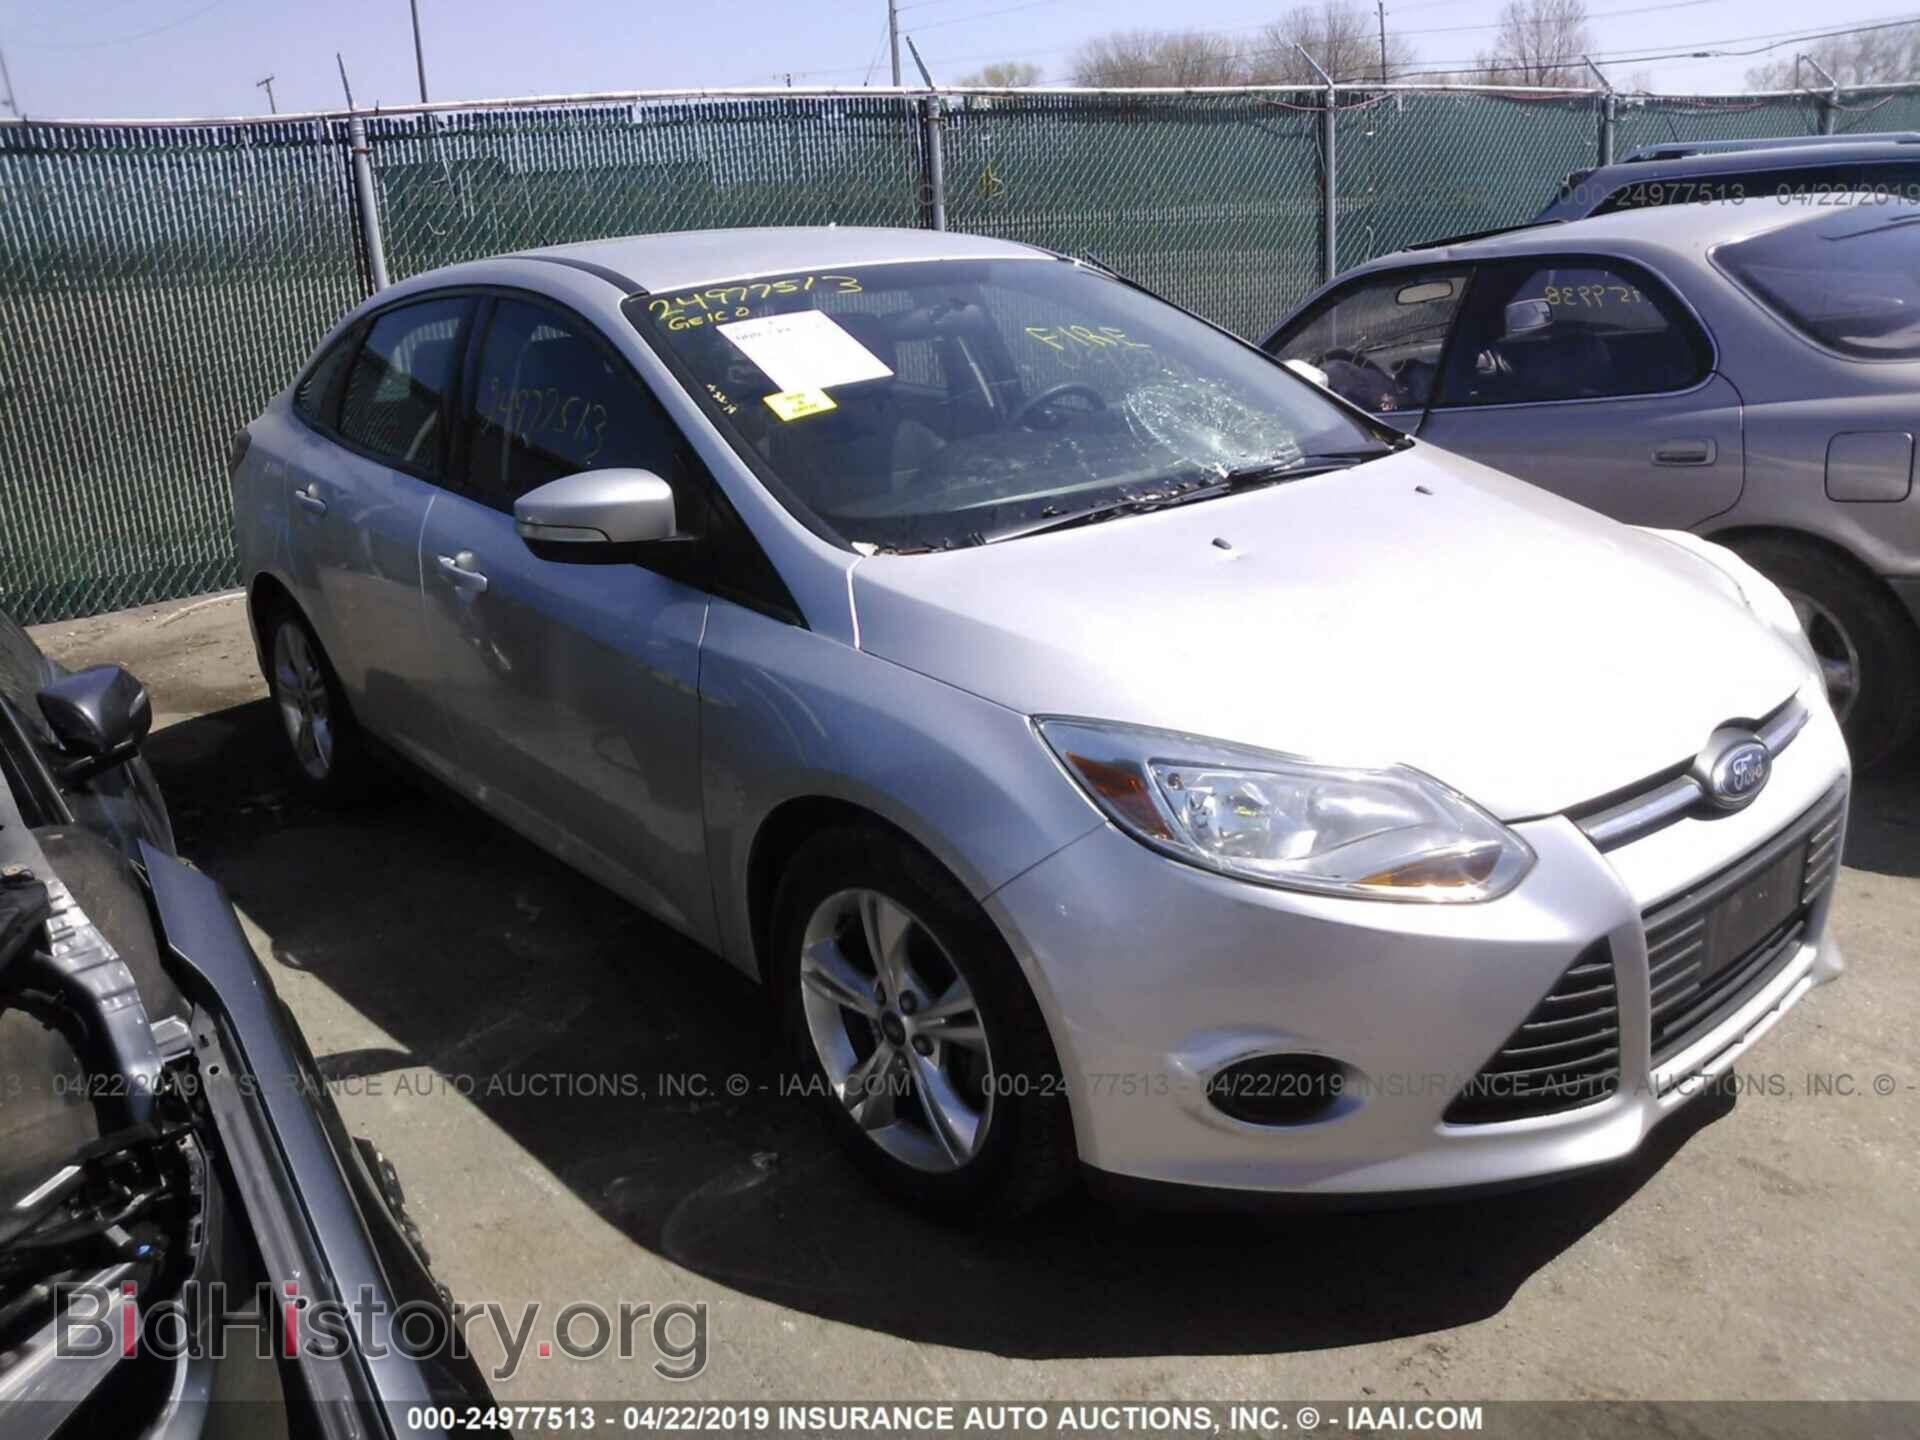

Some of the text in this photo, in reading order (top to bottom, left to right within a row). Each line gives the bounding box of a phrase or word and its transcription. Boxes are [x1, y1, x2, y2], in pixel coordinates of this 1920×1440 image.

[649, 276, 863, 320] 24977513
[1025, 325, 1152, 350] FIRE
[1732, 753, 1764, 791] Ford
